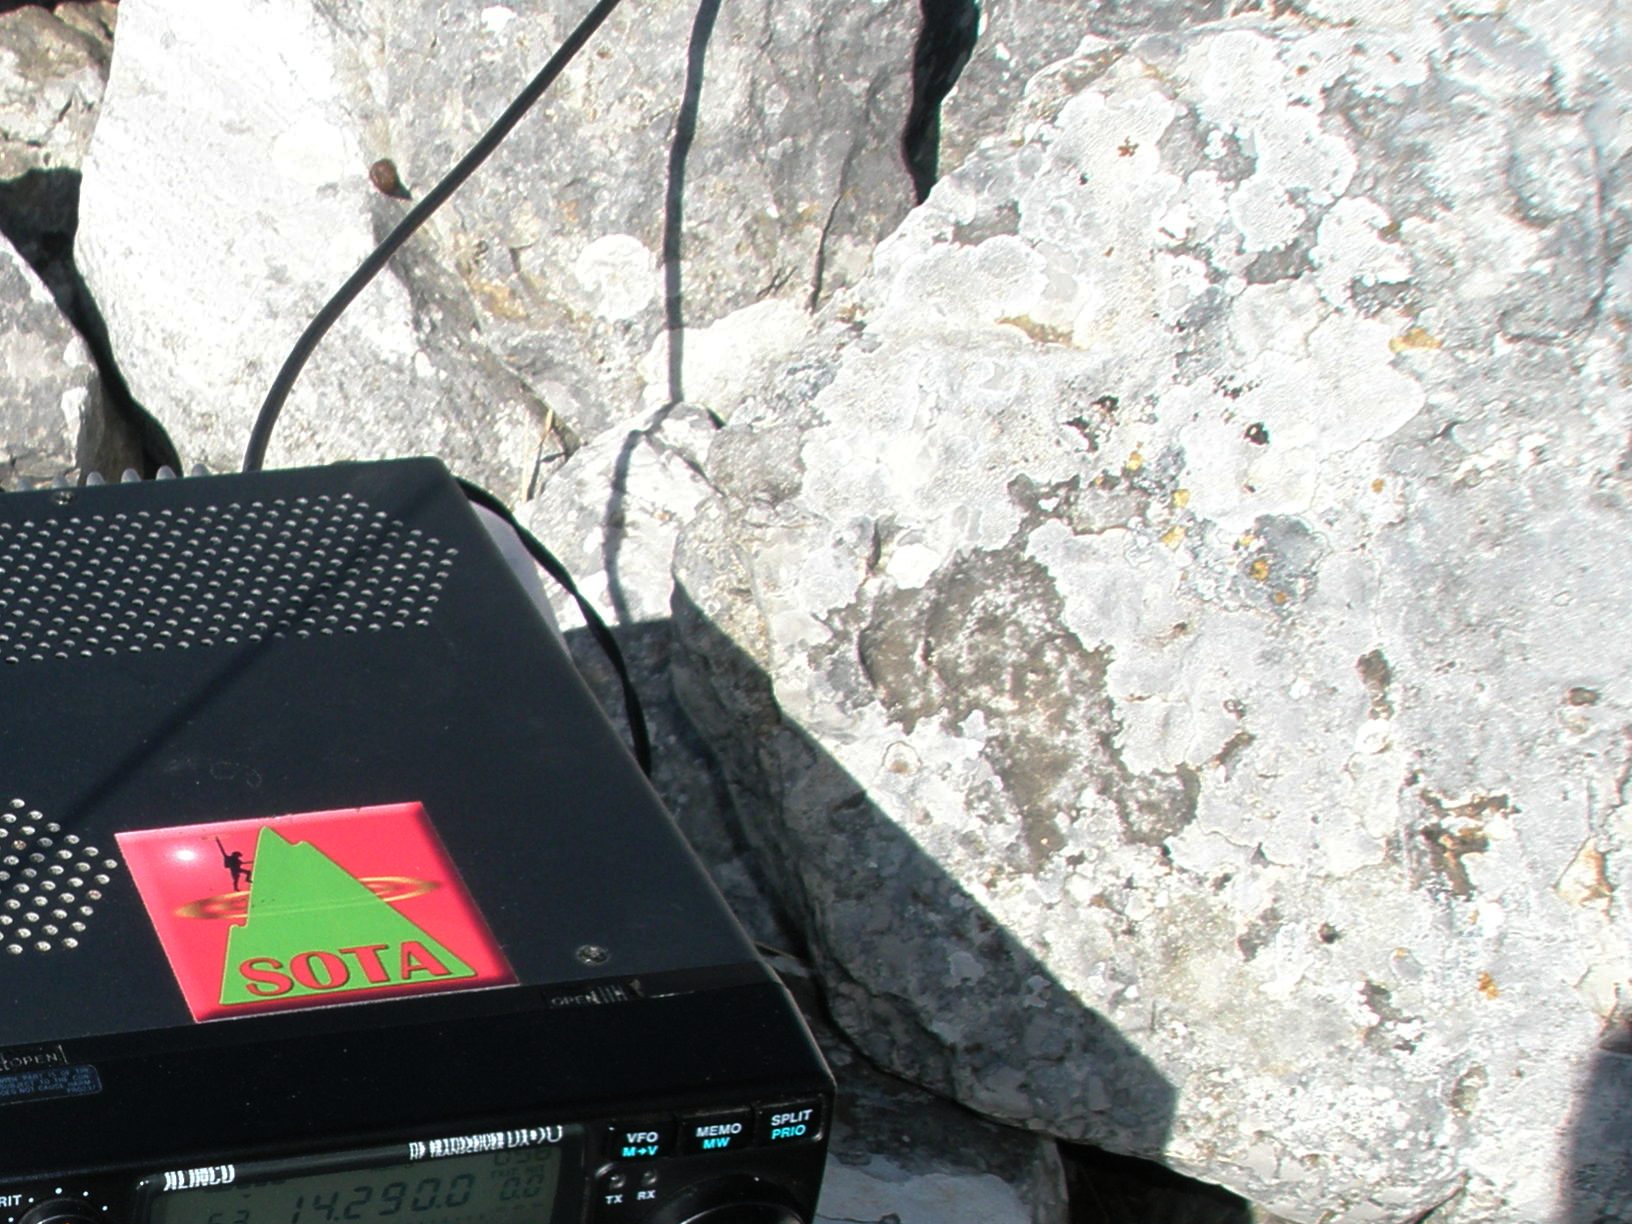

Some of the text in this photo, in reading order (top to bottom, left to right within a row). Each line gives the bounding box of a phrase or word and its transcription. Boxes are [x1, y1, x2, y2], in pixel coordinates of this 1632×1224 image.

[239, 940, 452, 996] SOTA
[770, 1108, 814, 1126] SPLIT
[626, 1131, 659, 1144] VFO
[695, 1122, 743, 1138] MEMO
[770, 1124, 807, 1140] PRIO
[702, 1136, 732, 1150] MW
[604, 1194, 624, 1205] TX
[636, 1189, 656, 1201] RX
